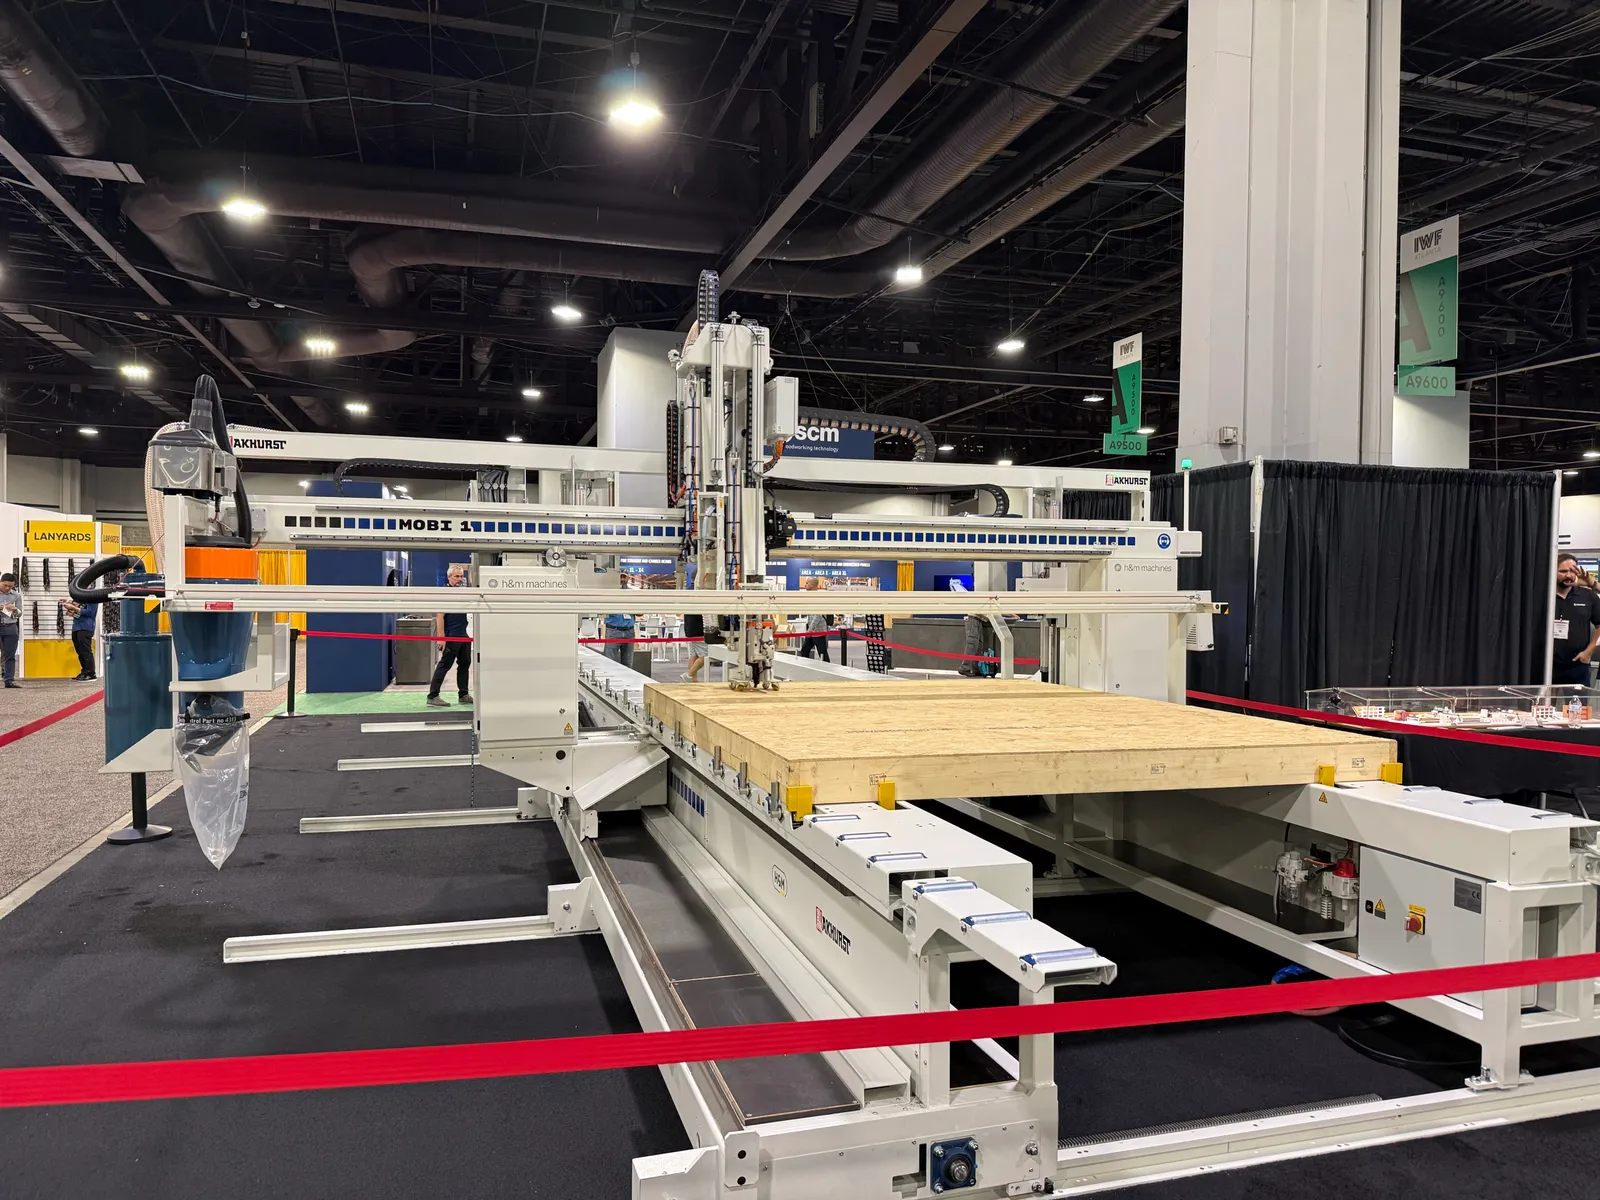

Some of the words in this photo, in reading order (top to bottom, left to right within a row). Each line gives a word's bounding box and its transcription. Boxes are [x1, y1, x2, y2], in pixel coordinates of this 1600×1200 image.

[1413, 228, 1443, 253] IWF
[1437, 276, 1446, 338] A9600
[1119, 340, 1135, 356] IWF
[1405, 375, 1448, 390] A9600
[794, 425, 840, 443] scm
[233, 438, 287, 450] AKHURST
[813, 445, 839, 453] technology
[1109, 440, 1142, 451] A9500
[1114, 476, 1149, 486] AKHURST
[399, 518, 453, 532] MOBI
[460, 520, 472, 532] 1
[34, 532, 91, 542] LANYARDS
[1123, 563, 1141, 572] h&m
[1141, 563, 1172, 572] machines
[501, 578, 524, 588] h&m
[525, 578, 568, 589] machines
[821, 915, 851, 956] AKHURST
